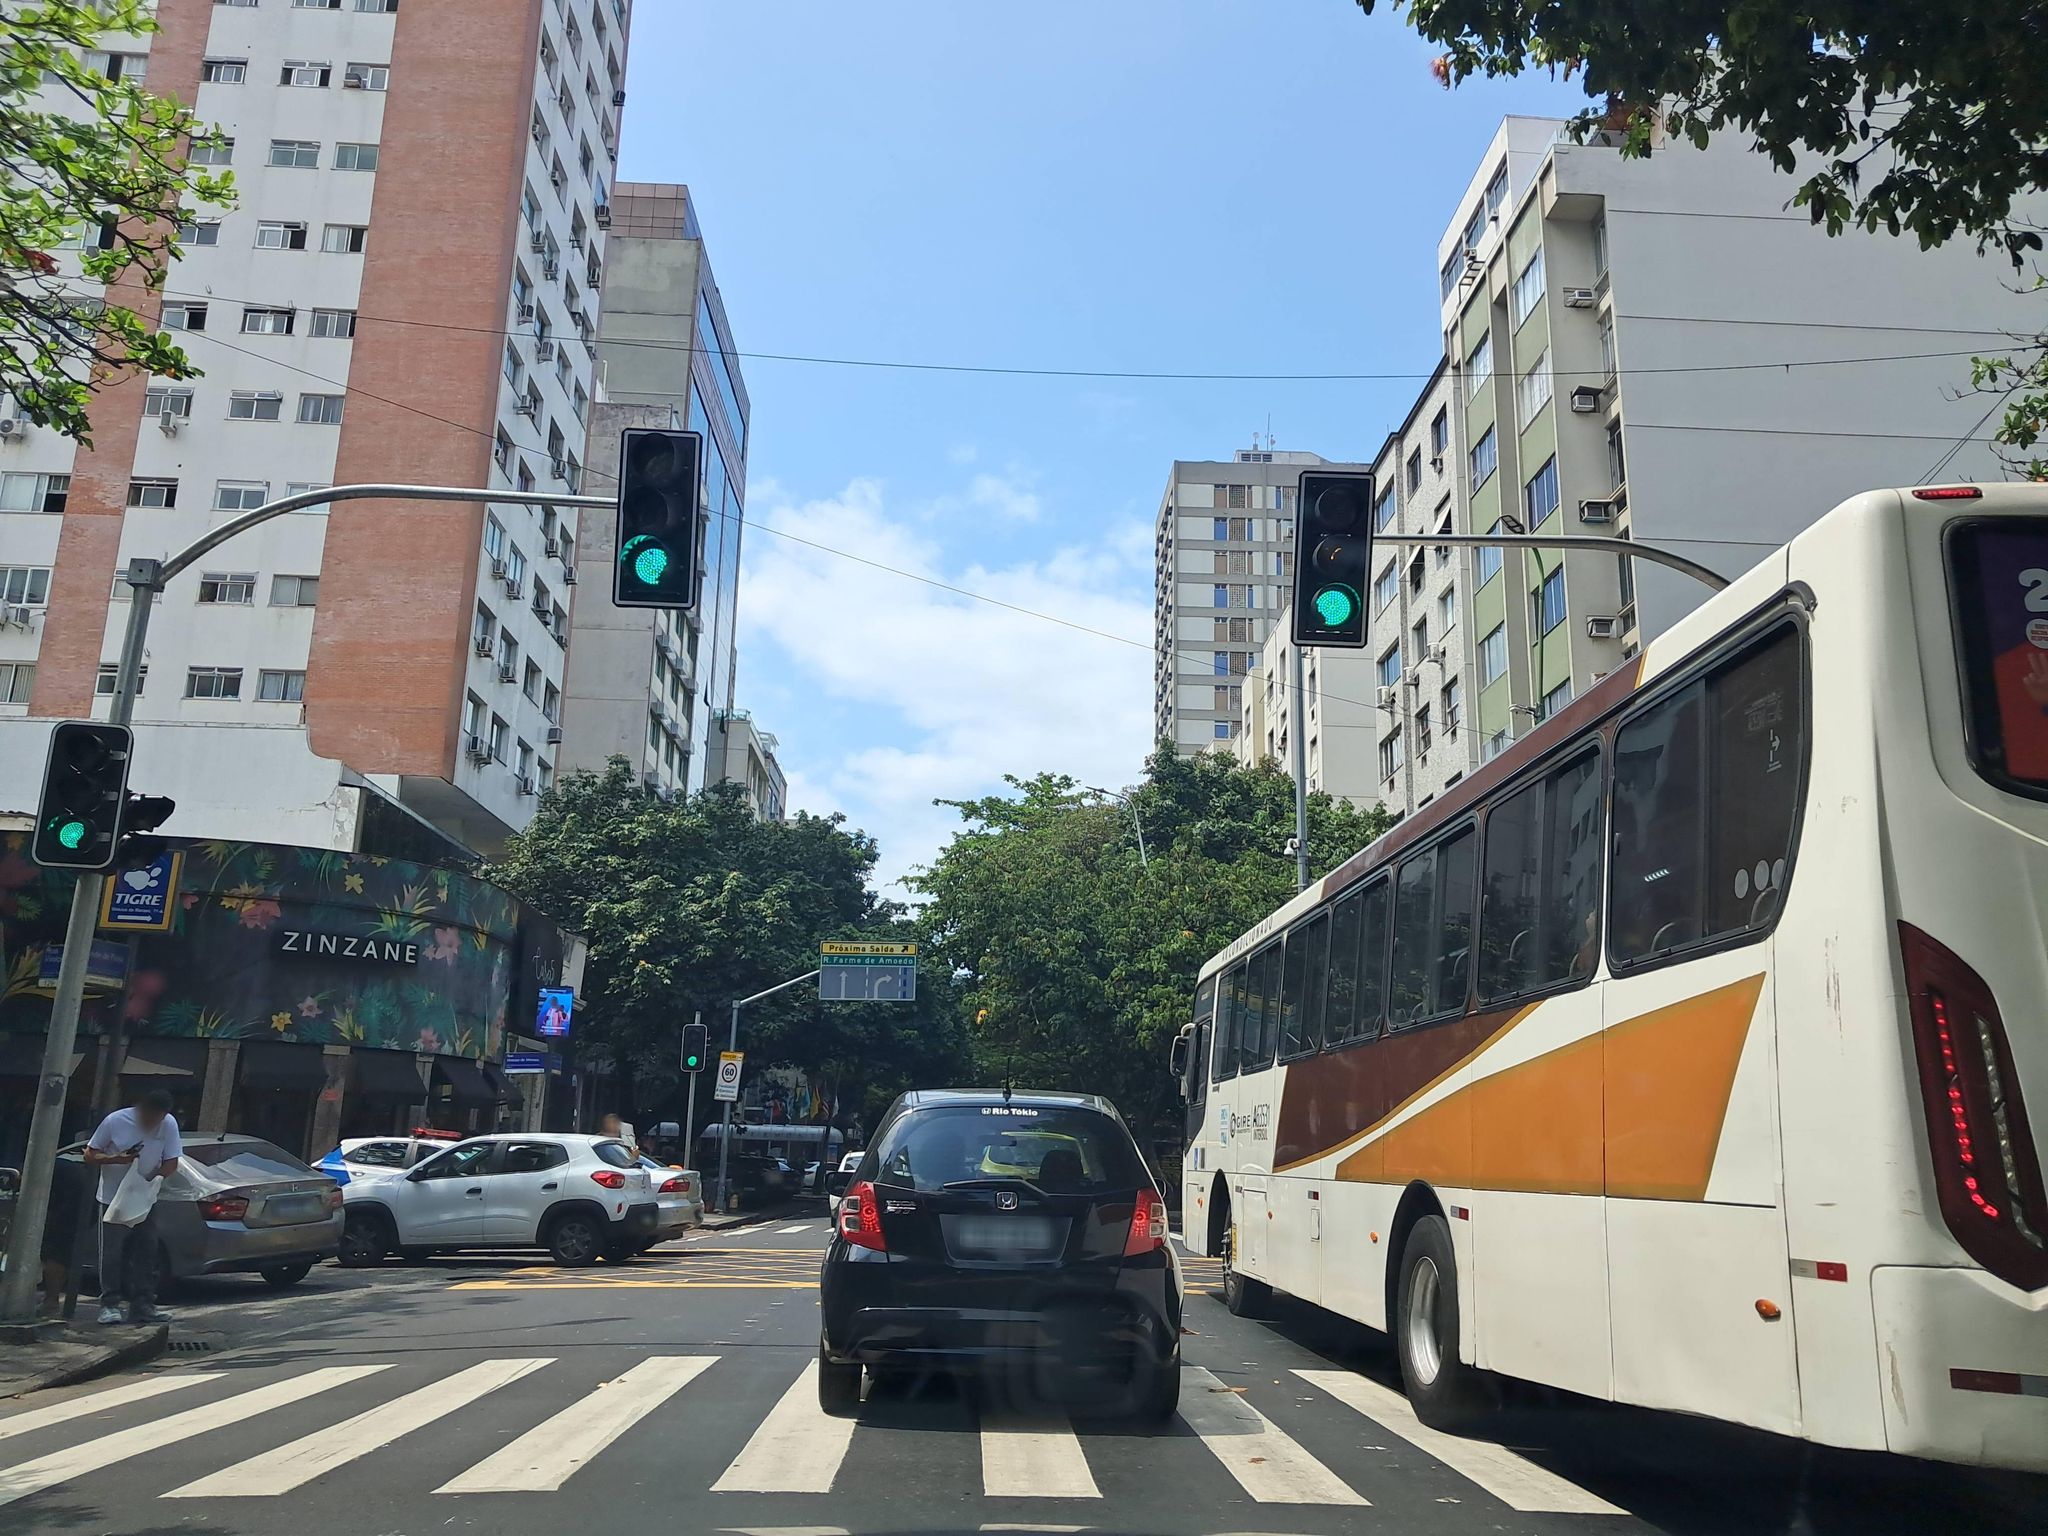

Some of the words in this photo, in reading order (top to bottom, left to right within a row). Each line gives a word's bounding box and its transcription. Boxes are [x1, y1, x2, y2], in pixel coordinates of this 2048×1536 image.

[115, 893, 163, 906] TIGRE
[281, 931, 417, 963] ZINZANE
[829, 943, 866, 953] Próxima
[833, 956, 861, 964] Farme
[878, 957, 914, 965] Amoedo
[724, 1067, 735, 1077] 60
[992, 1107, 1010, 1115] Rio
